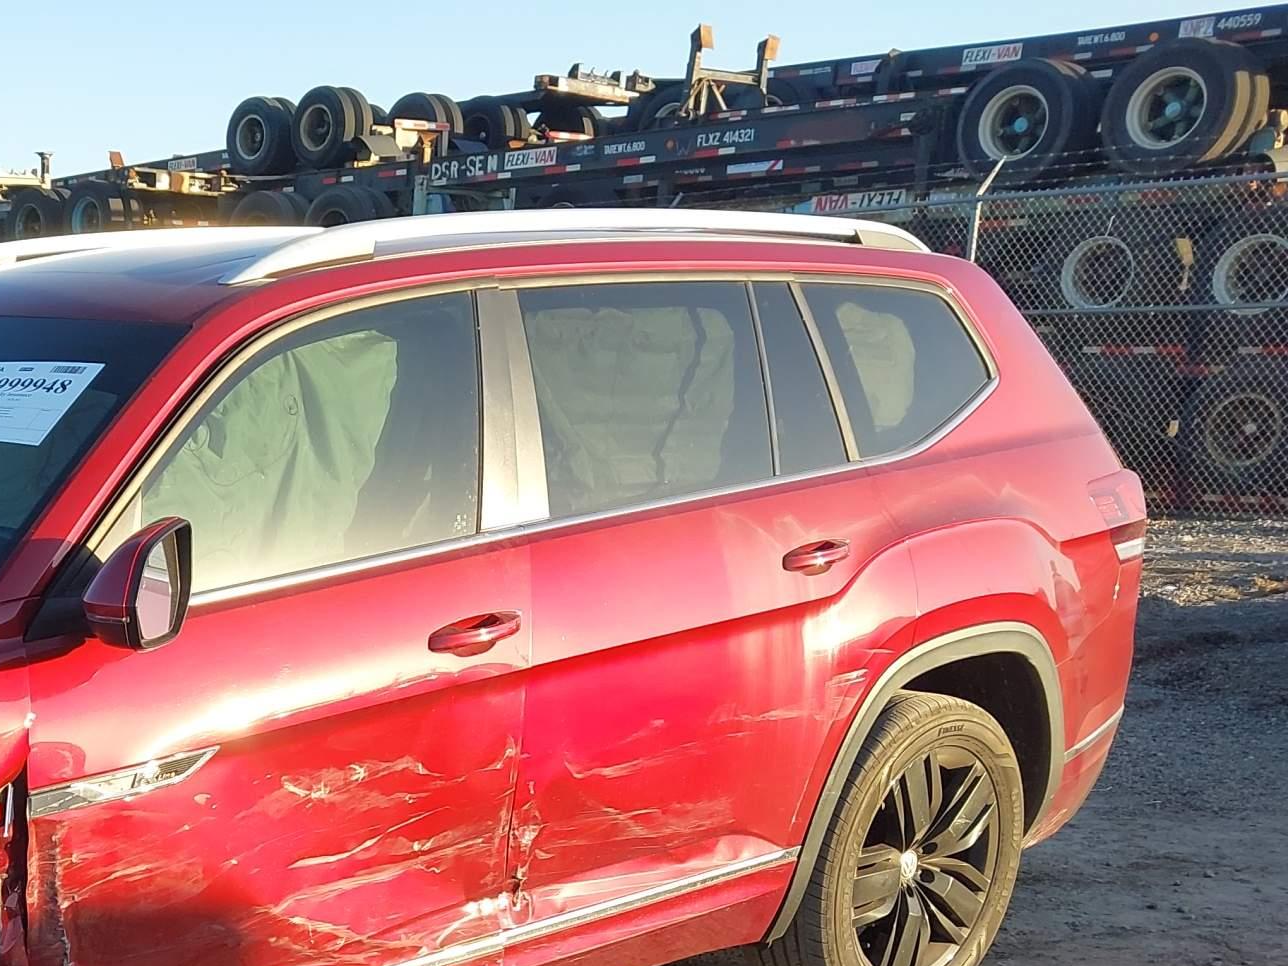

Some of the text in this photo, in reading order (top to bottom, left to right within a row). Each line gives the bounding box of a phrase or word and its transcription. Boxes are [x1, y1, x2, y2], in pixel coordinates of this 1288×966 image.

[1217, 13, 1262, 30] 440559
[964, 45, 1020, 64] FLEXI-VAN
[697, 128, 755, 147] FLXZ 414321
[506, 149, 555, 168] FLEXI-VAN
